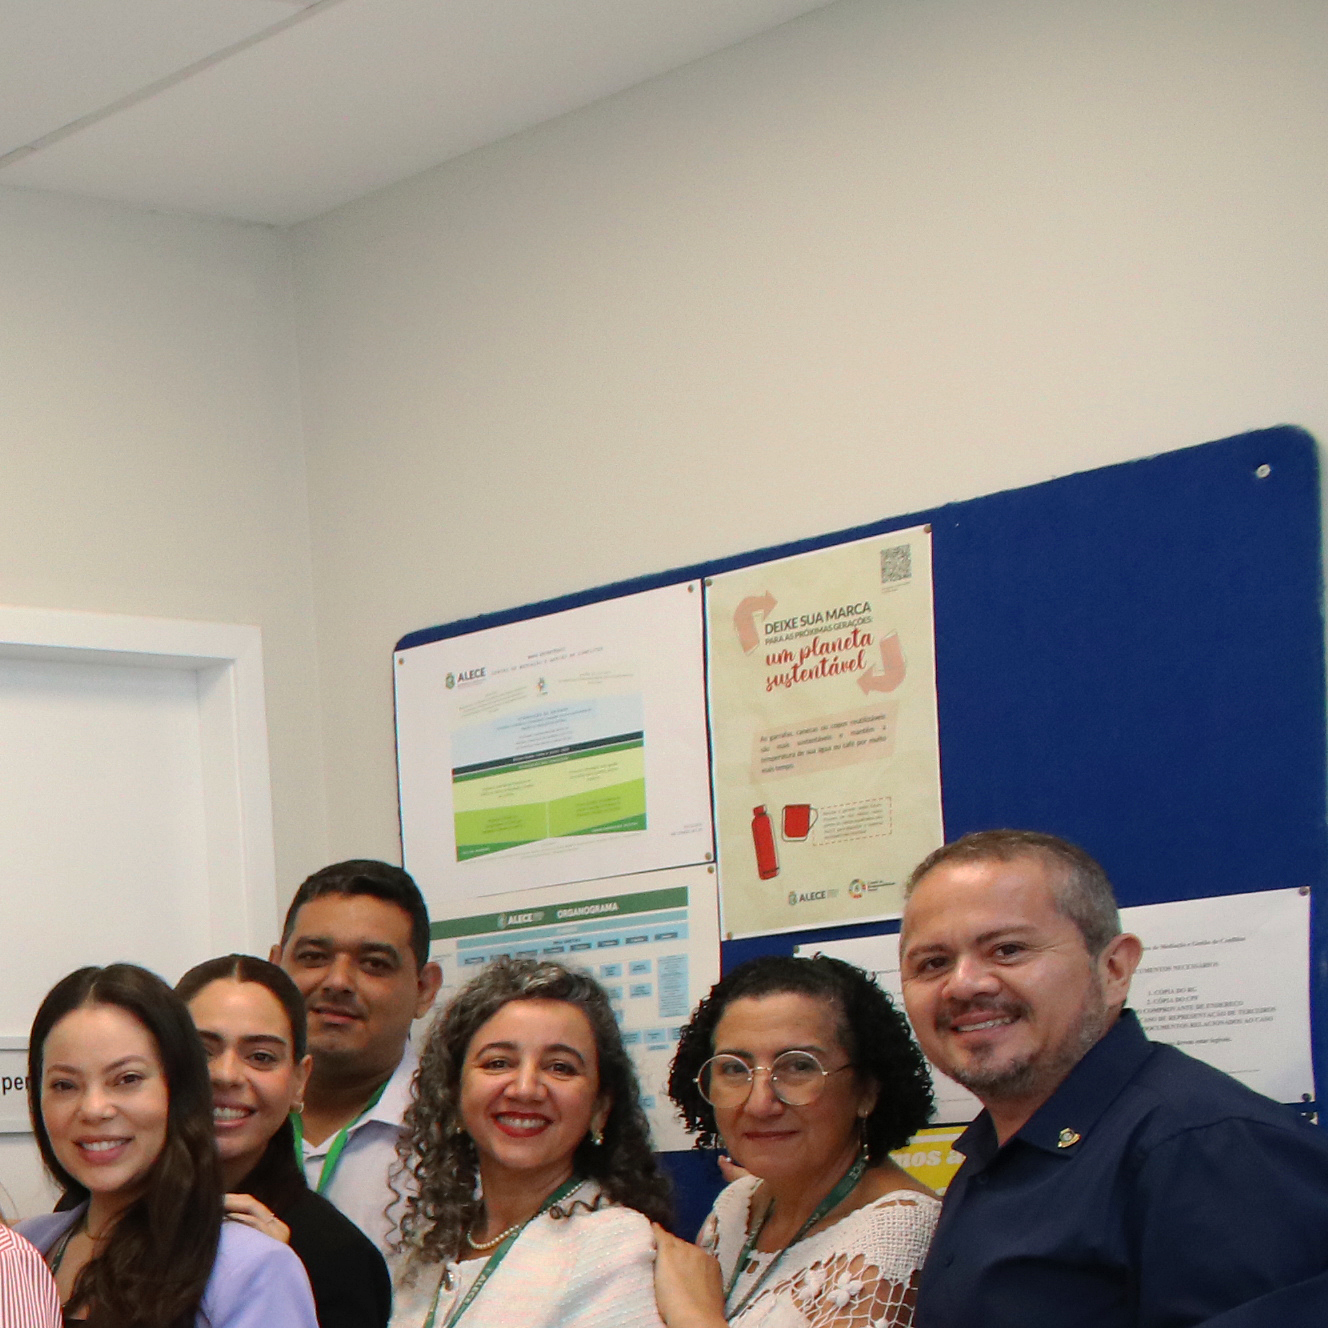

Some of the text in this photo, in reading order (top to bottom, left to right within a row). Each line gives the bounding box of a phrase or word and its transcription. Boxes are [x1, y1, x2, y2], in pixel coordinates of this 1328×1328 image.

[765, 601, 872, 635] DEIXE SUA MARCA
[765, 634, 784, 645] PARA
[784, 633, 794, 642] AS
[766, 628, 874, 668] um planeta
[457, 667, 486, 683] ALECE
[765, 650, 868, 692] sustentável
[799, 890, 826, 902] ALECE
[507, 902, 619, 926] ALECE ORGANOGRAMA
